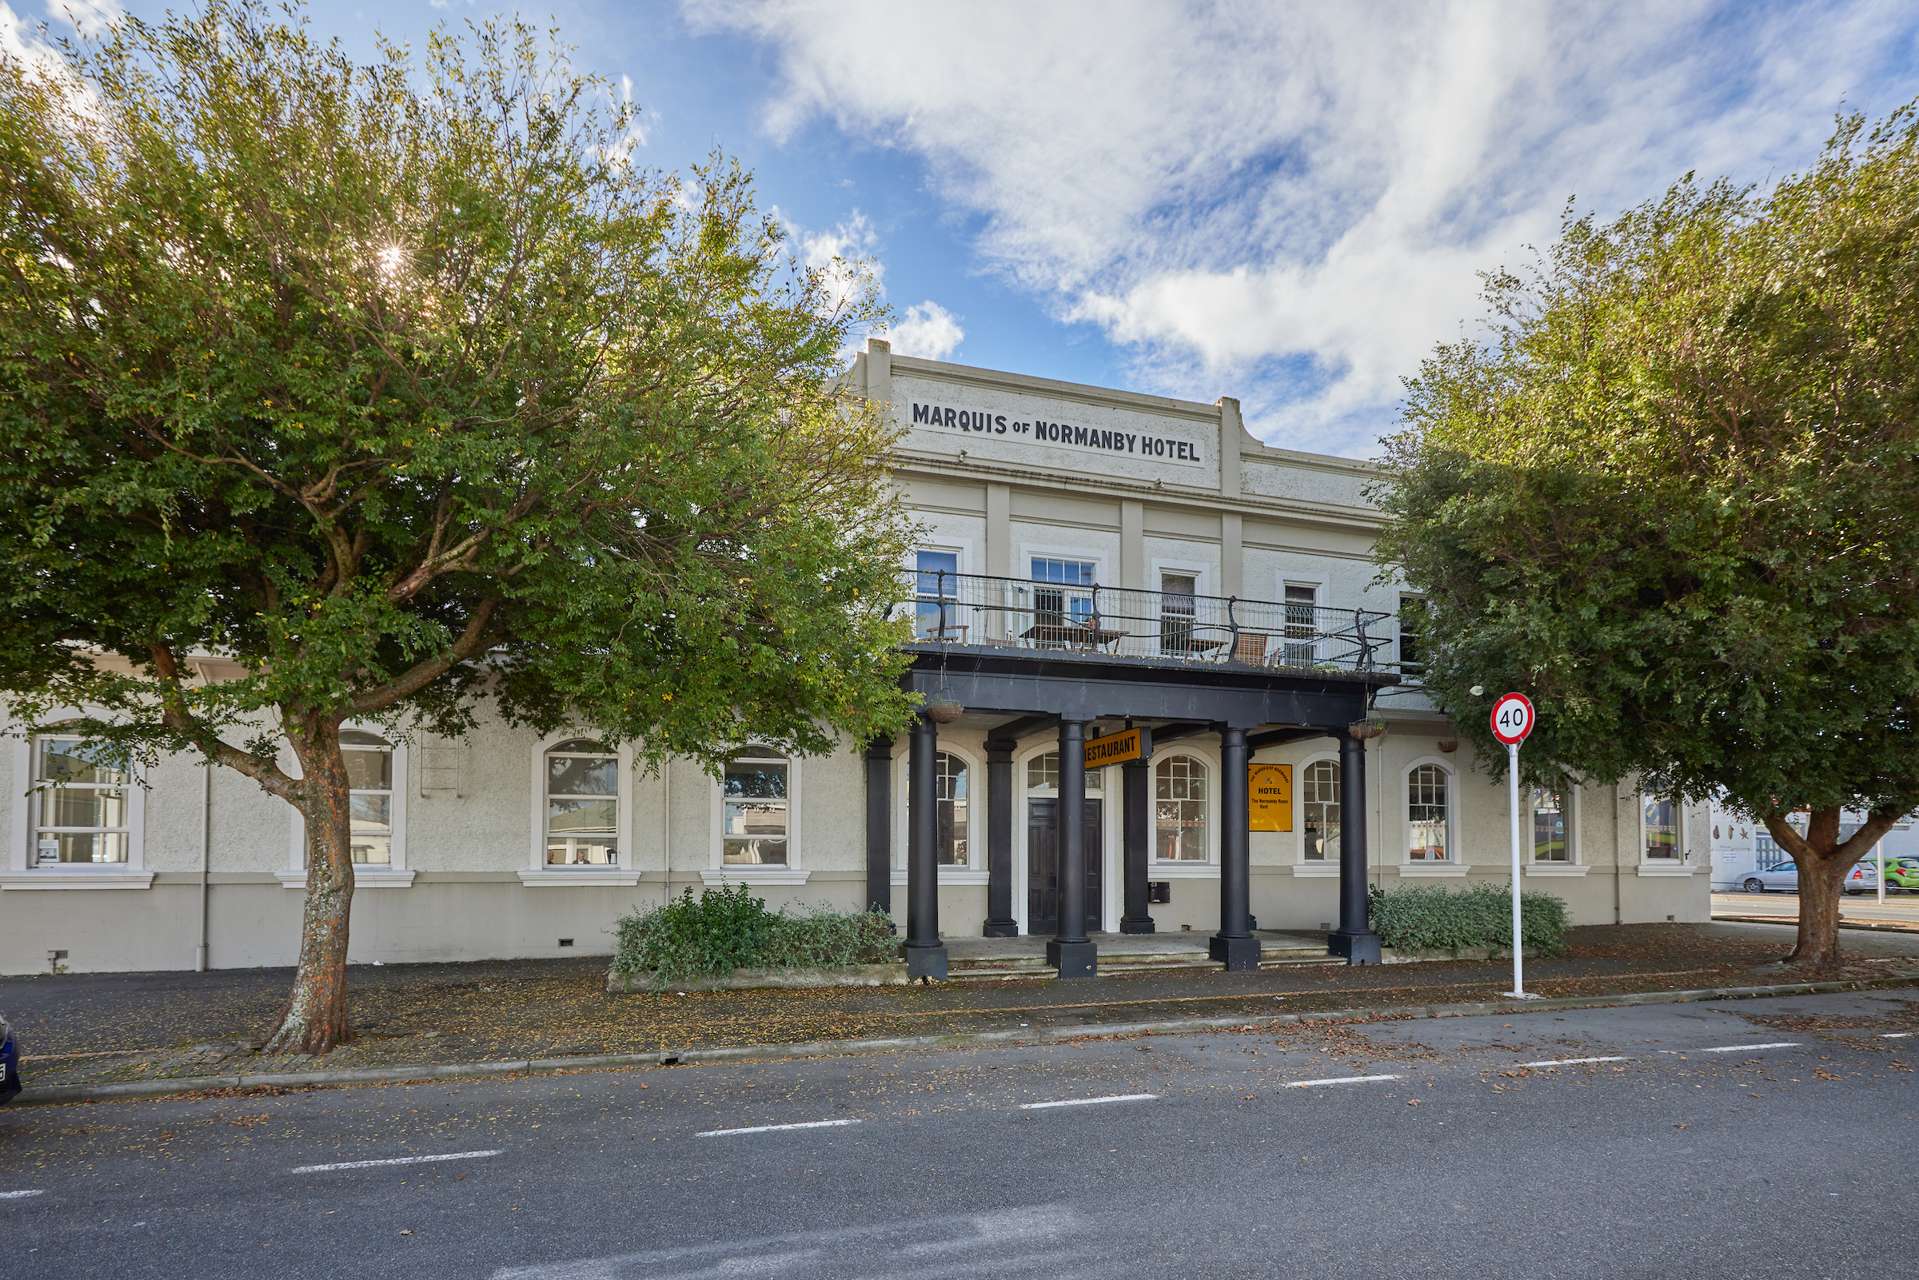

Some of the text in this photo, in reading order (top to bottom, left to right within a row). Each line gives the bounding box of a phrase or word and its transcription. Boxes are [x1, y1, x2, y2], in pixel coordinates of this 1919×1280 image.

[913, 402, 1200, 462] MARQUIS OF NORMANBY HOTEL
[1499, 708, 1523, 728] 40
[1258, 787, 1281, 795] HOTEL
